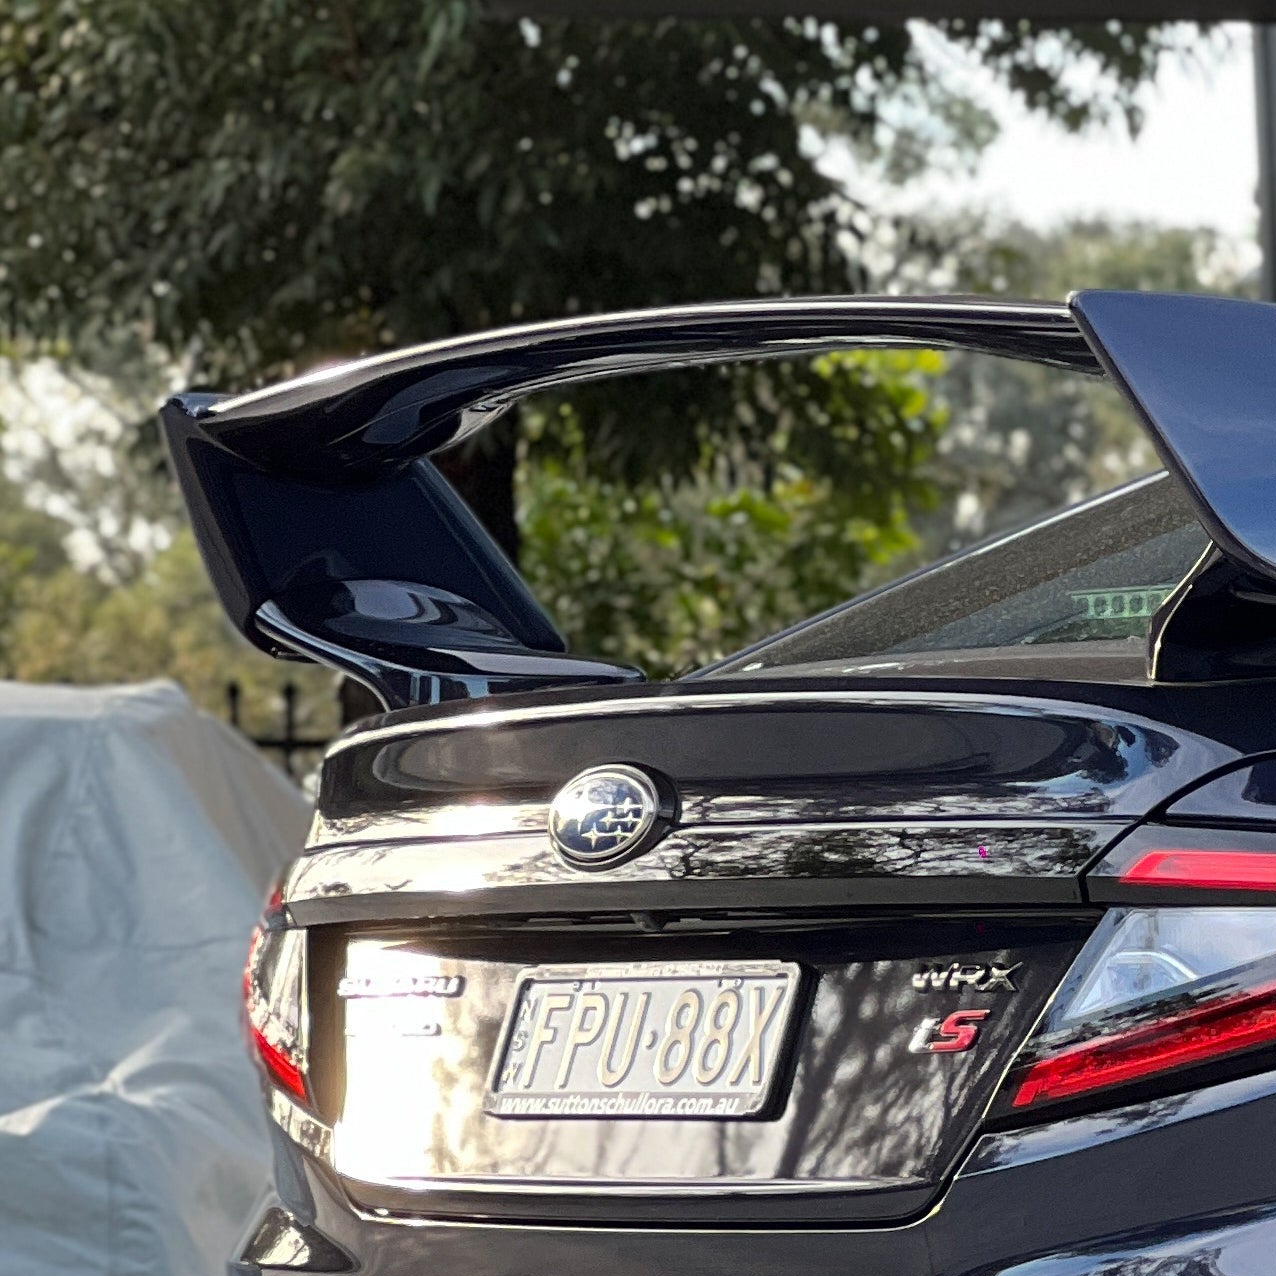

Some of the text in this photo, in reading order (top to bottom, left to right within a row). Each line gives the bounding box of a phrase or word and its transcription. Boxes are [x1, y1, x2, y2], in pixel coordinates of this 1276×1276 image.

[337, 975, 461, 997] SUARU
[912, 960, 1024, 993] WRX
[500, 1092, 740, 1115] www.suttonschullora.com.au
